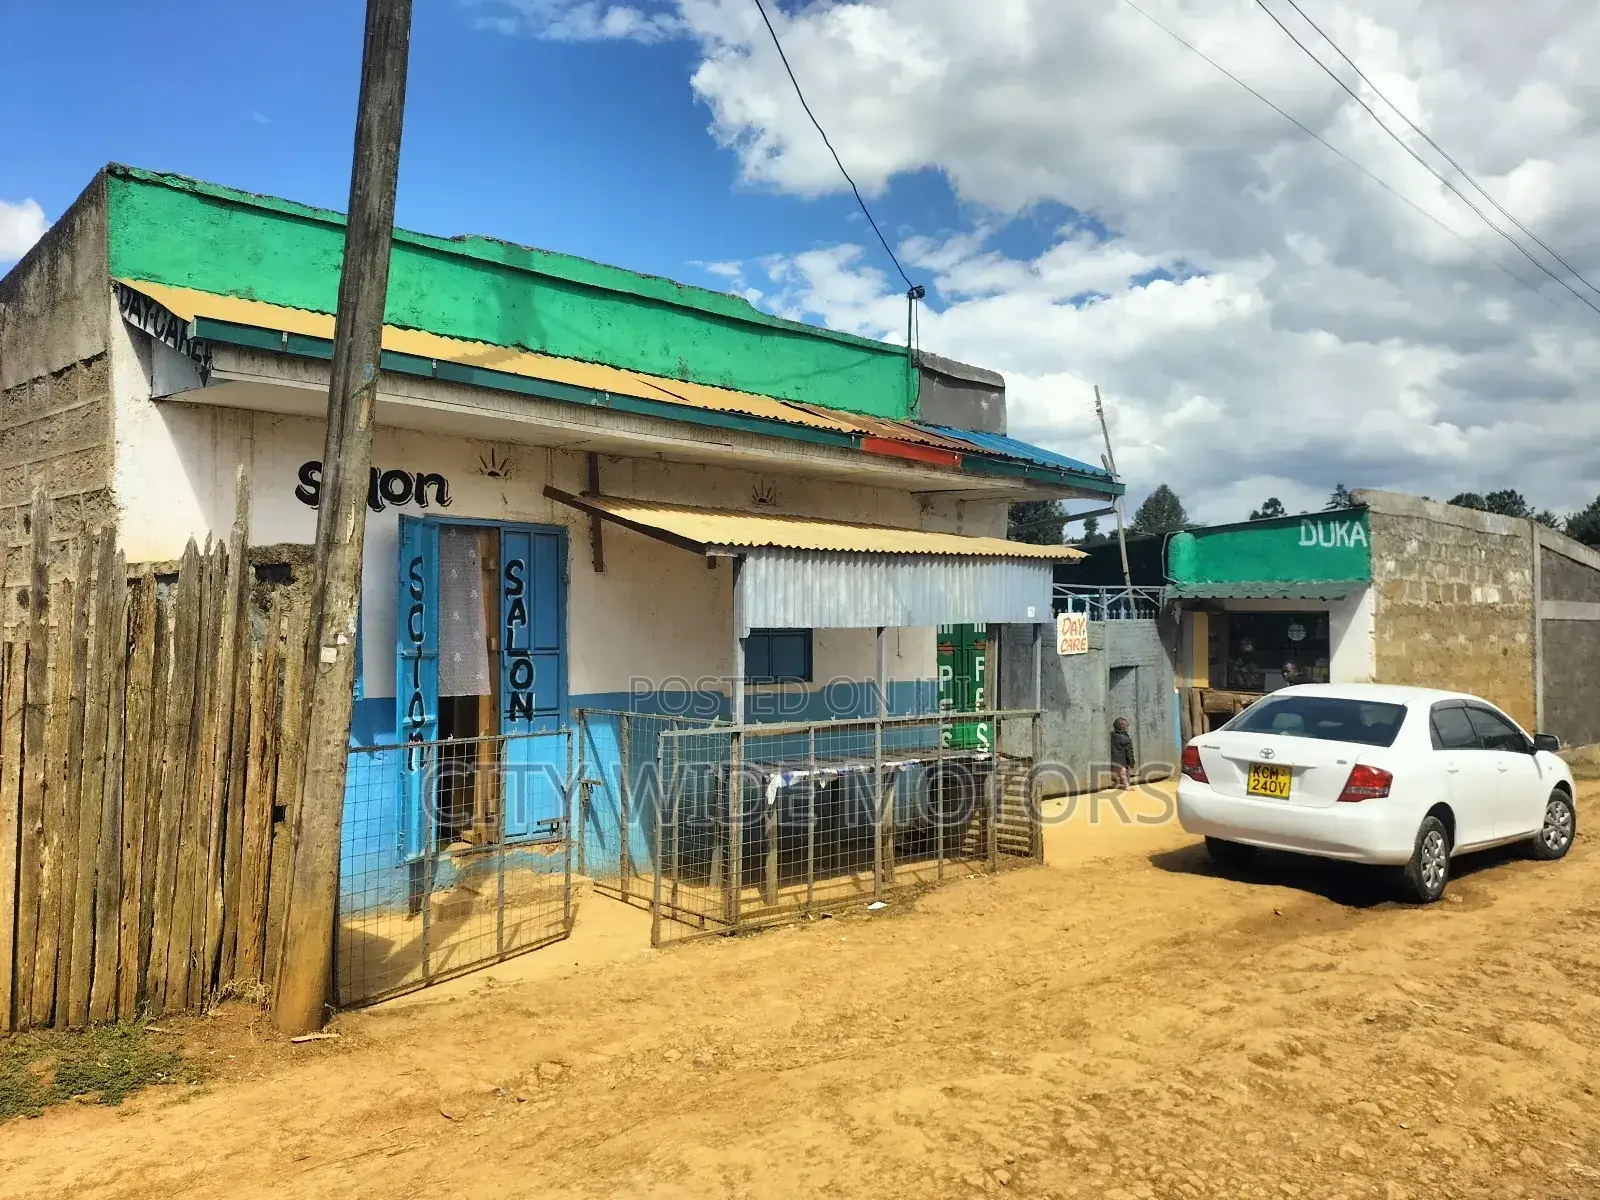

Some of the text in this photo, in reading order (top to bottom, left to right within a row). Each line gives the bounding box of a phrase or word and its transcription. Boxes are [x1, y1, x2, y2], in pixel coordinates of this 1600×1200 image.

[295, 460, 452, 512] Slon
[1299, 519, 1368, 548] DUKA
[1062, 616, 1086, 636] DAY
[504, 558, 536, 723] SALON
[1061, 637, 1087, 653] CARE
[1253, 764, 1279, 780] KCM
[1252, 779, 1286, 795] 240V
